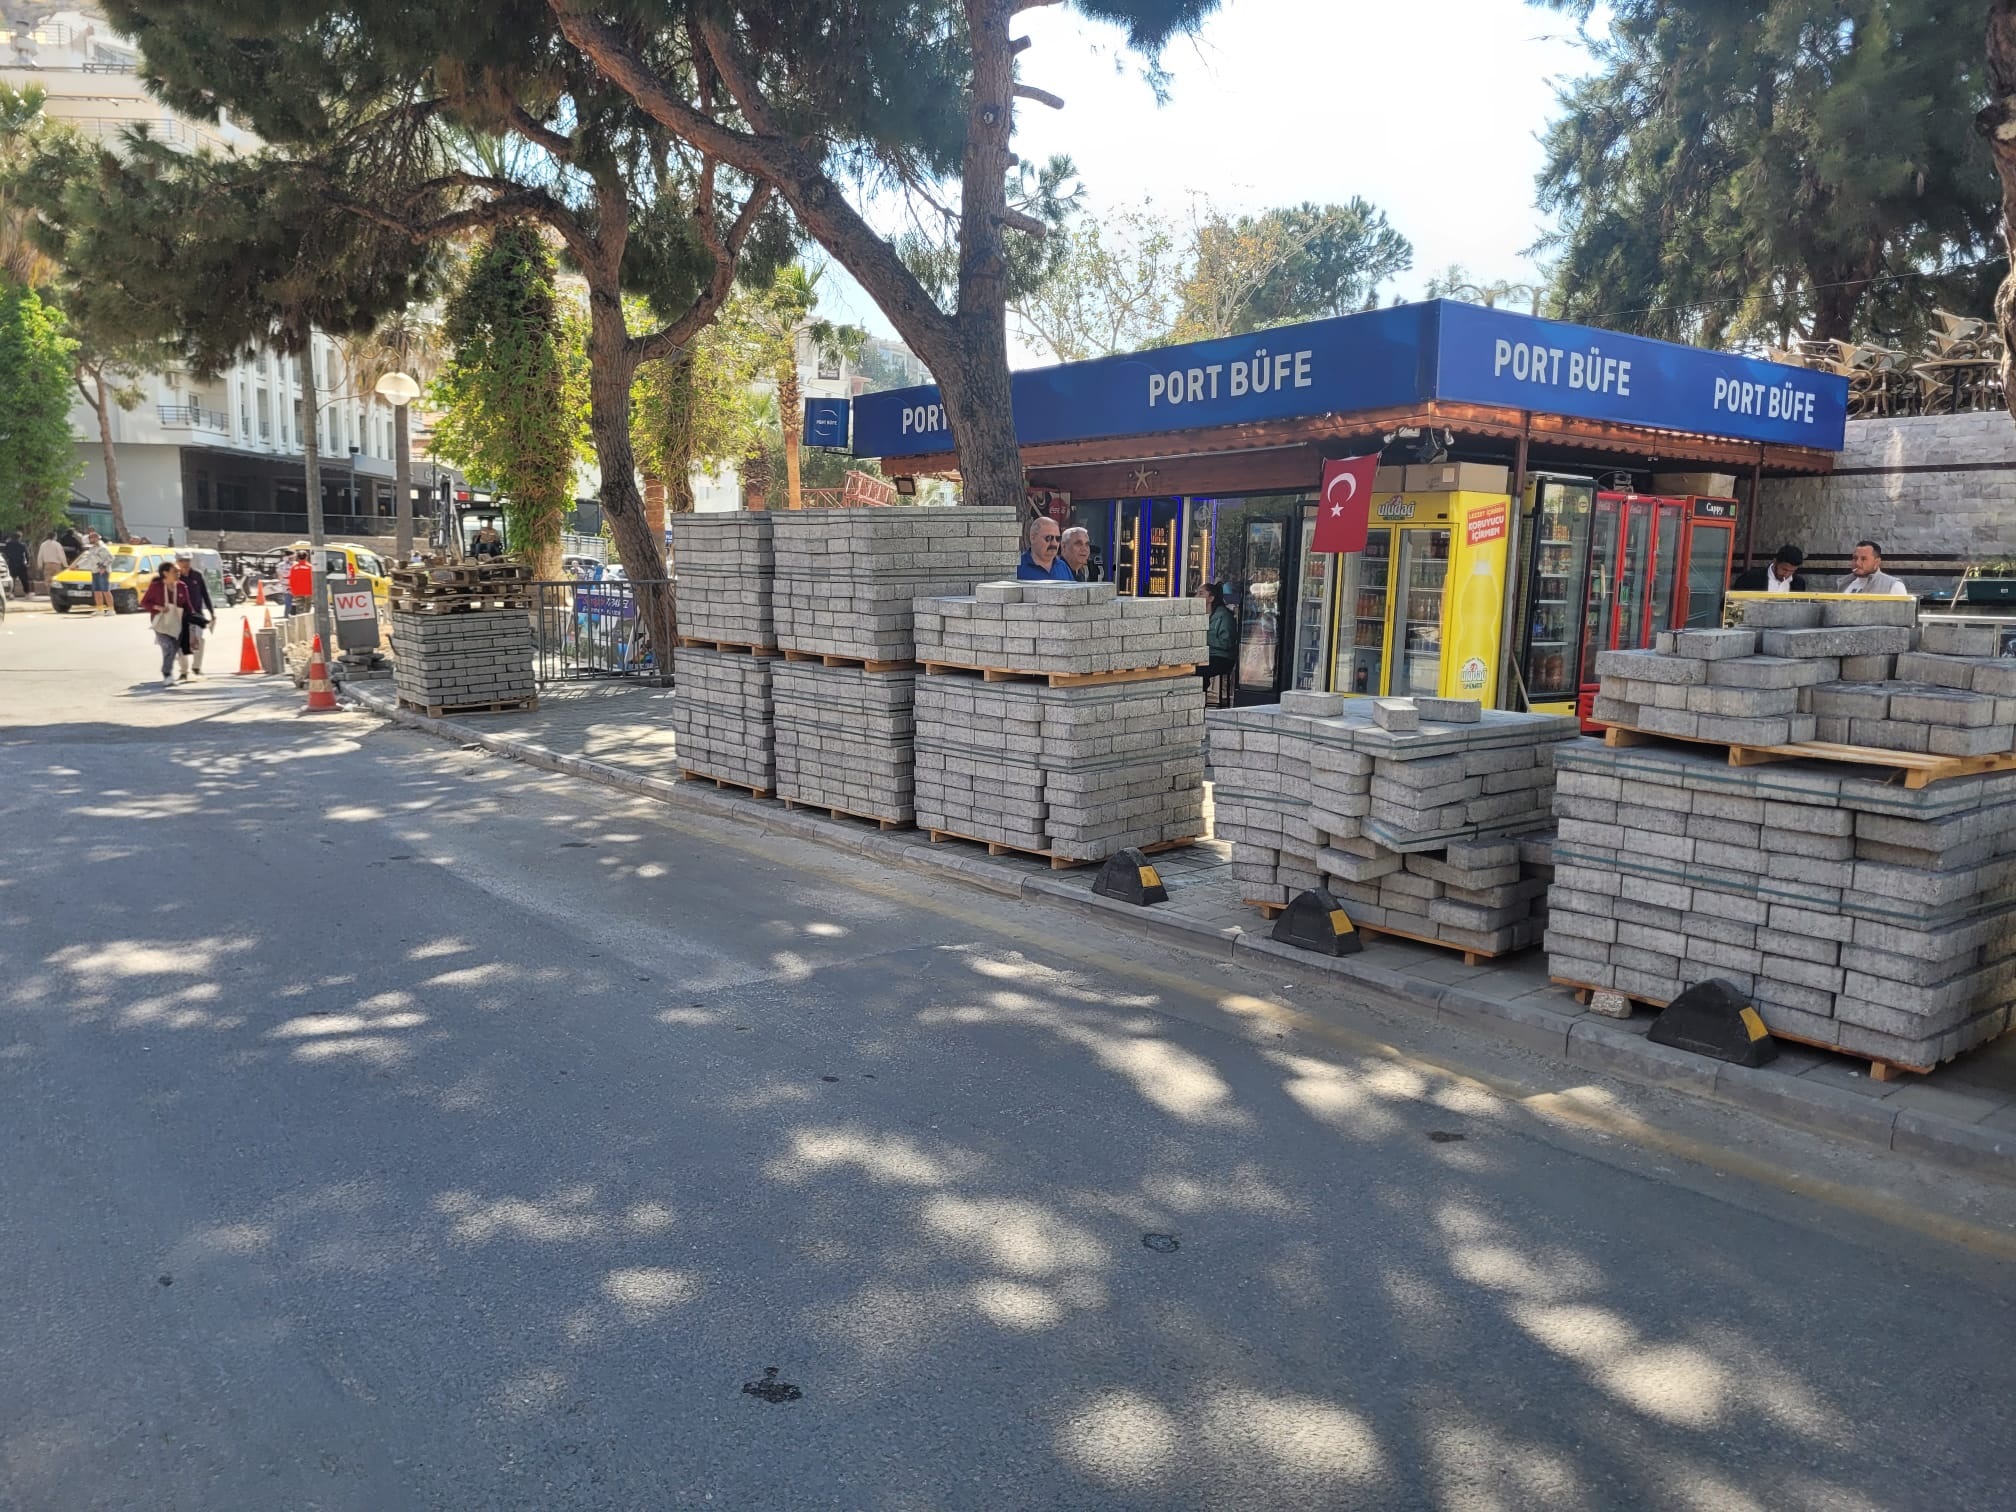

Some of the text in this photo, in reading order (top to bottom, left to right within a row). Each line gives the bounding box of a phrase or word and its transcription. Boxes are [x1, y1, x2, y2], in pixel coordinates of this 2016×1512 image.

[1495, 339, 1632, 397] PORT BÜFE
[1149, 348, 1313, 407] PORT BÜFE
[1713, 377, 1816, 424] PORT BÜFE
[1377, 501, 1415, 518] uludağ
[1706, 502, 1725, 517] Cappy
[1468, 515, 1505, 531] KORUYUCU
[336, 595, 368, 609] WC
